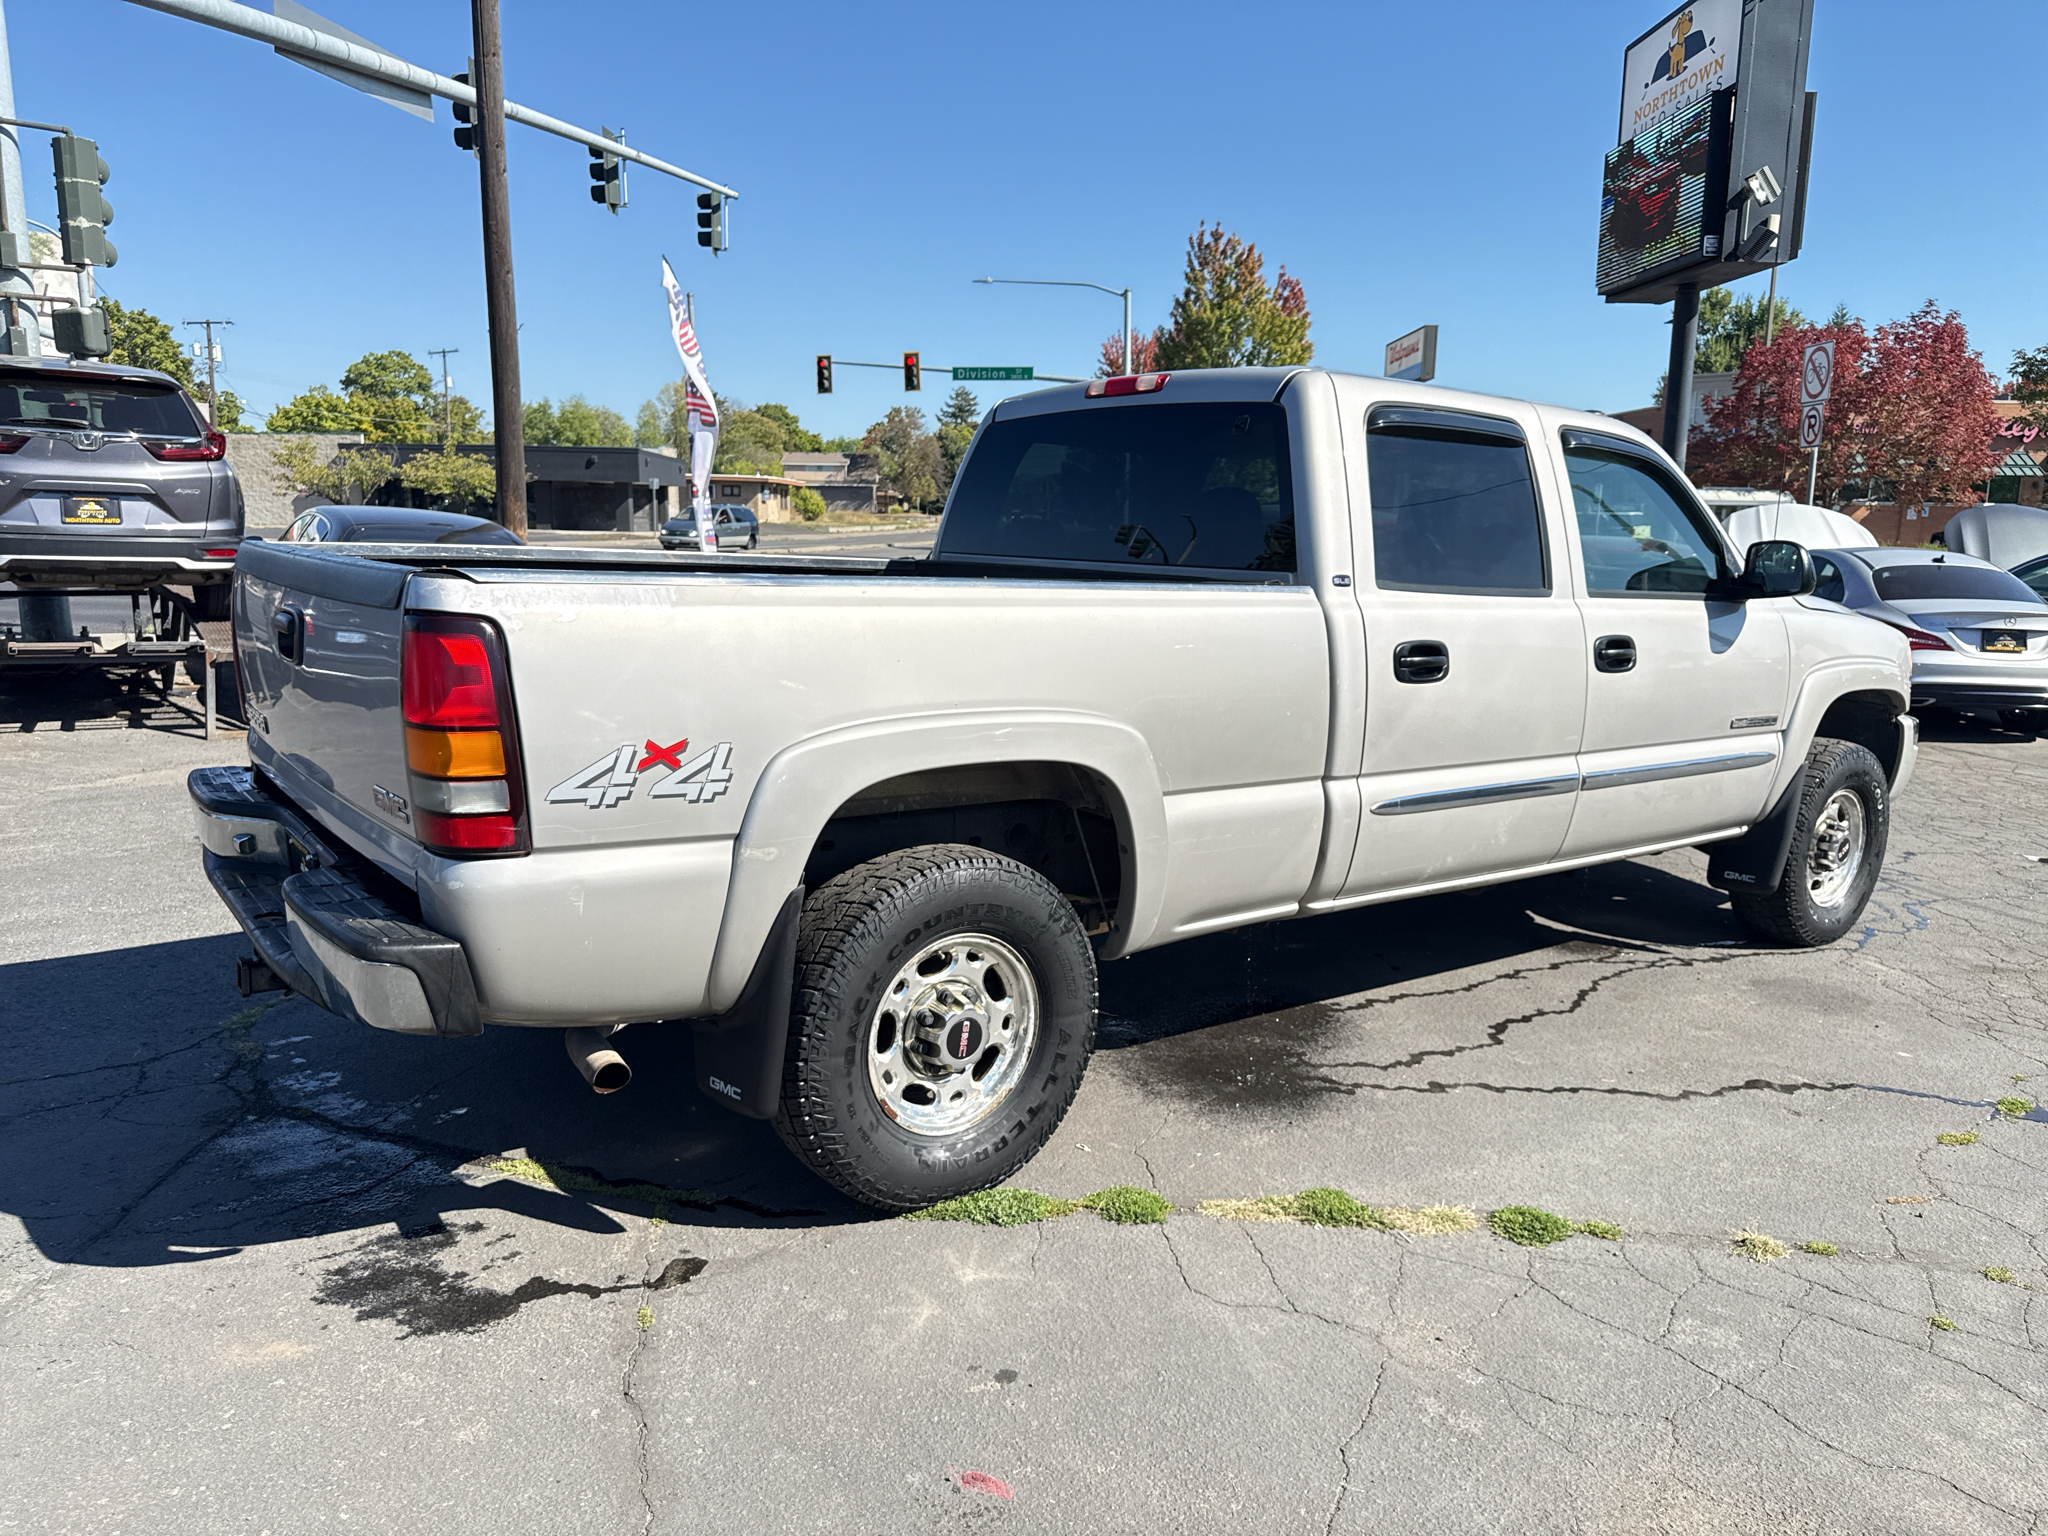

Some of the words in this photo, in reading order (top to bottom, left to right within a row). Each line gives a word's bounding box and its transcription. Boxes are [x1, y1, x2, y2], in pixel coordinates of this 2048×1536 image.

[1633, 53, 1725, 125] NORTHTOWN
[957, 368, 1006, 379] Division
[372, 784, 411, 825] GMC
[1724, 870, 1756, 883] GMC
[886, 902, 1023, 962] COUNTRY
[957, 1020, 971, 1058] GMC
[1041, 1027, 1072, 1093] ALL
[709, 1075, 742, 1101] GMC
[918, 1101, 1046, 1175] TERRAIN
